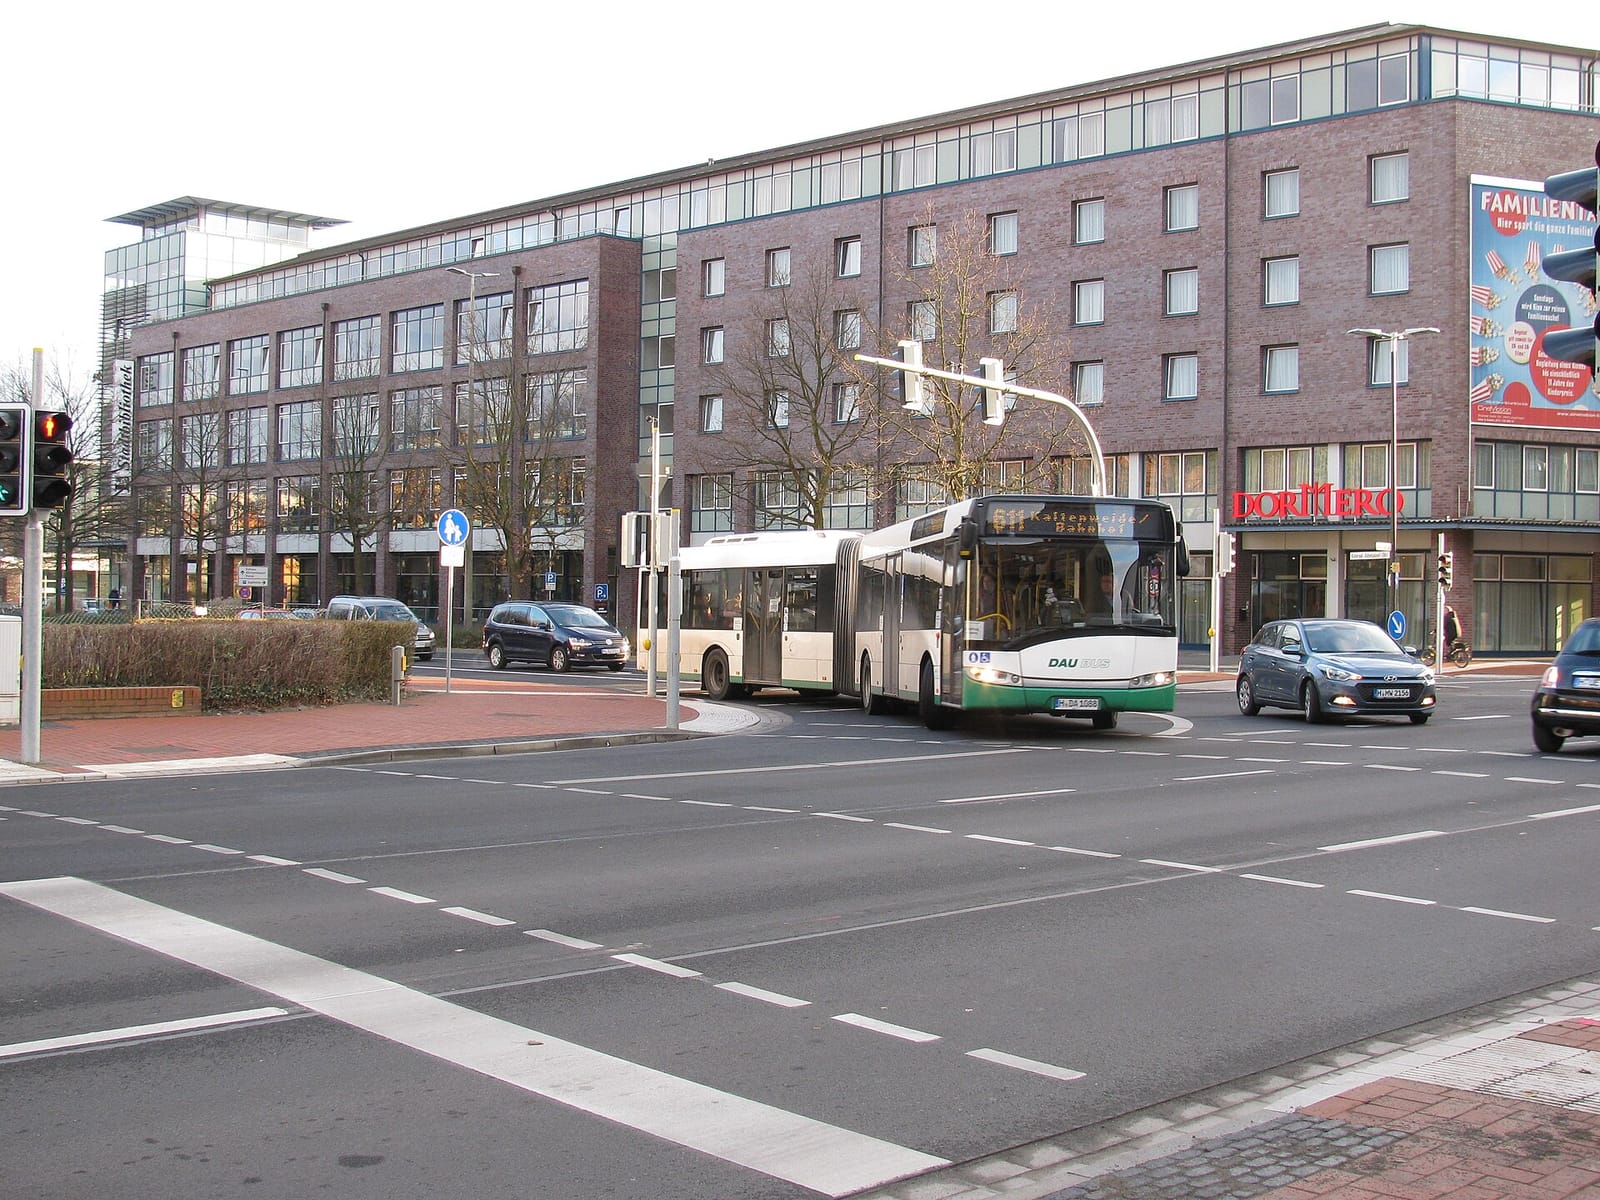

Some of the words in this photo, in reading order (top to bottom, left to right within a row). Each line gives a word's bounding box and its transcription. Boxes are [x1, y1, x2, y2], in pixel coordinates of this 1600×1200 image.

[1497, 217, 1512, 229] Hier
[1514, 221, 1532, 232] spart
[1534, 222, 1545, 232] die
[1546, 225, 1566, 235] ganze
[119, 364, 133, 472] Stadtbibliothek
[1056, 522, 1126, 534] Bahnhof
[1048, 658, 1079, 668] DAU
